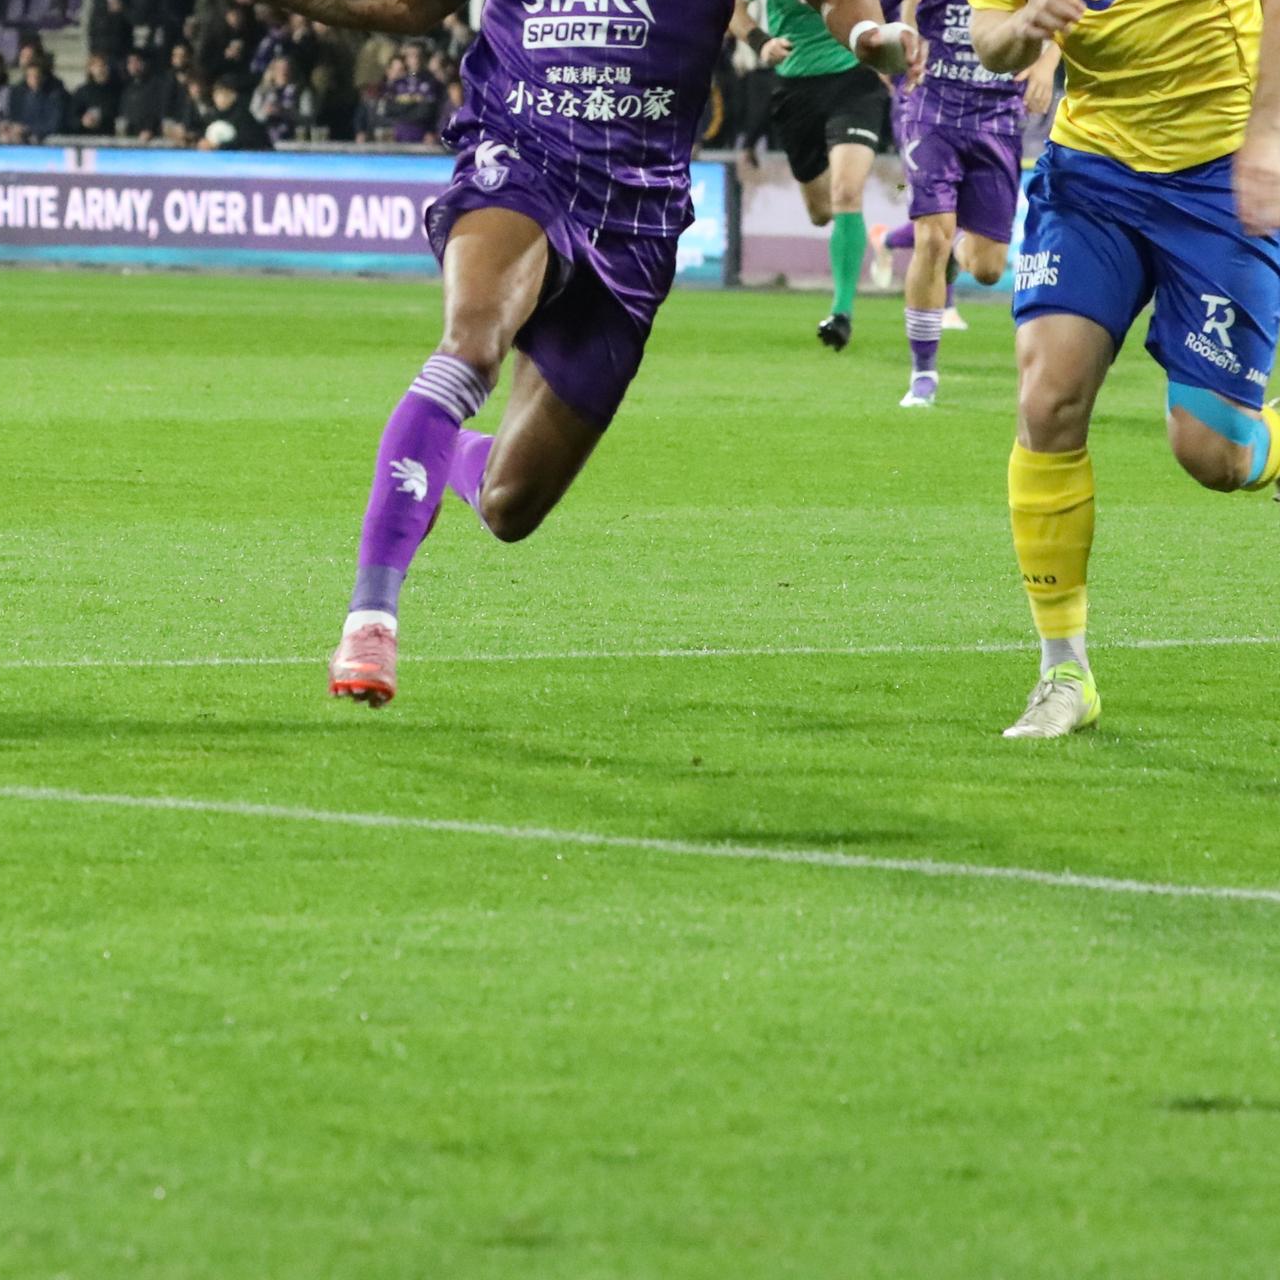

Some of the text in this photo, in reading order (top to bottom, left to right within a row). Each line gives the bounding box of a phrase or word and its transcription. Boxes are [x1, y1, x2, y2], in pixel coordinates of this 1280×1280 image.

[527, 22, 643, 44] SPORT TV
[506, 80, 676, 121] 小さな森の家
[64, 186, 159, 239] ARMY,
[163, 189, 248, 235] OVER
[252, 191, 340, 238] LAND
[345, 194, 417, 240] AND
[1185, 331, 1242, 375] Roosens
